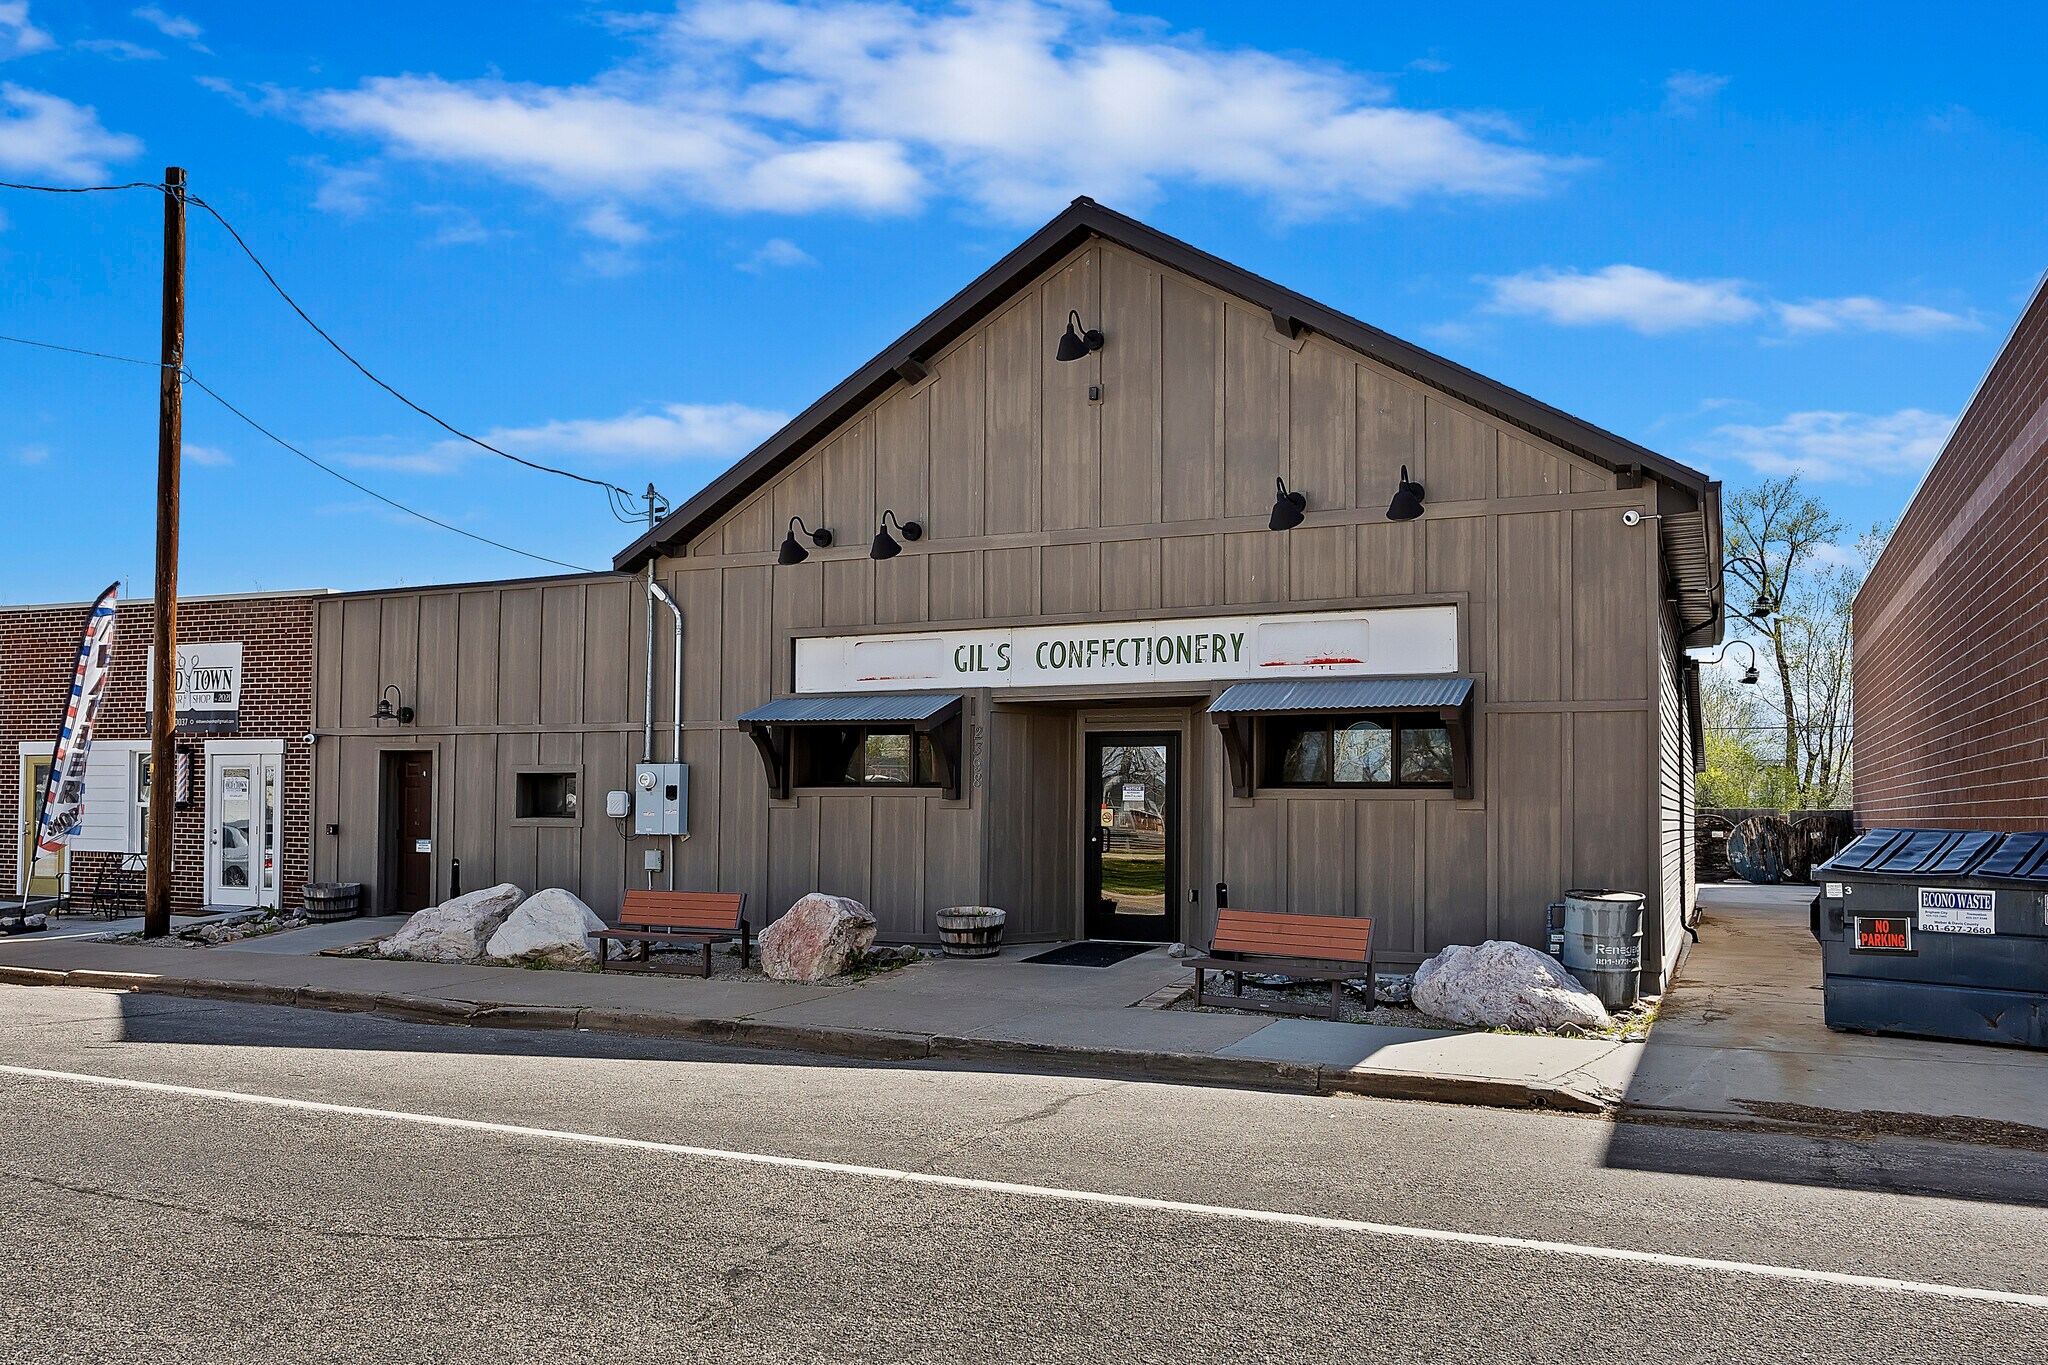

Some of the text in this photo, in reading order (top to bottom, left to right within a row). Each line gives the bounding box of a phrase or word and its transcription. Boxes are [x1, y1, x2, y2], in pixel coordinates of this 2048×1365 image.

[954, 643, 1011, 672] GIL'S
[193, 669, 233, 691] TOWN
[192, 694, 211, 704] SHOP
[1922, 892, 1991, 910] ECONO WASTE
[1875, 920, 1889, 933] NO
[1922, 923, 1992, 934] 801-627-2680
[1861, 933, 1905, 947] PARKING
